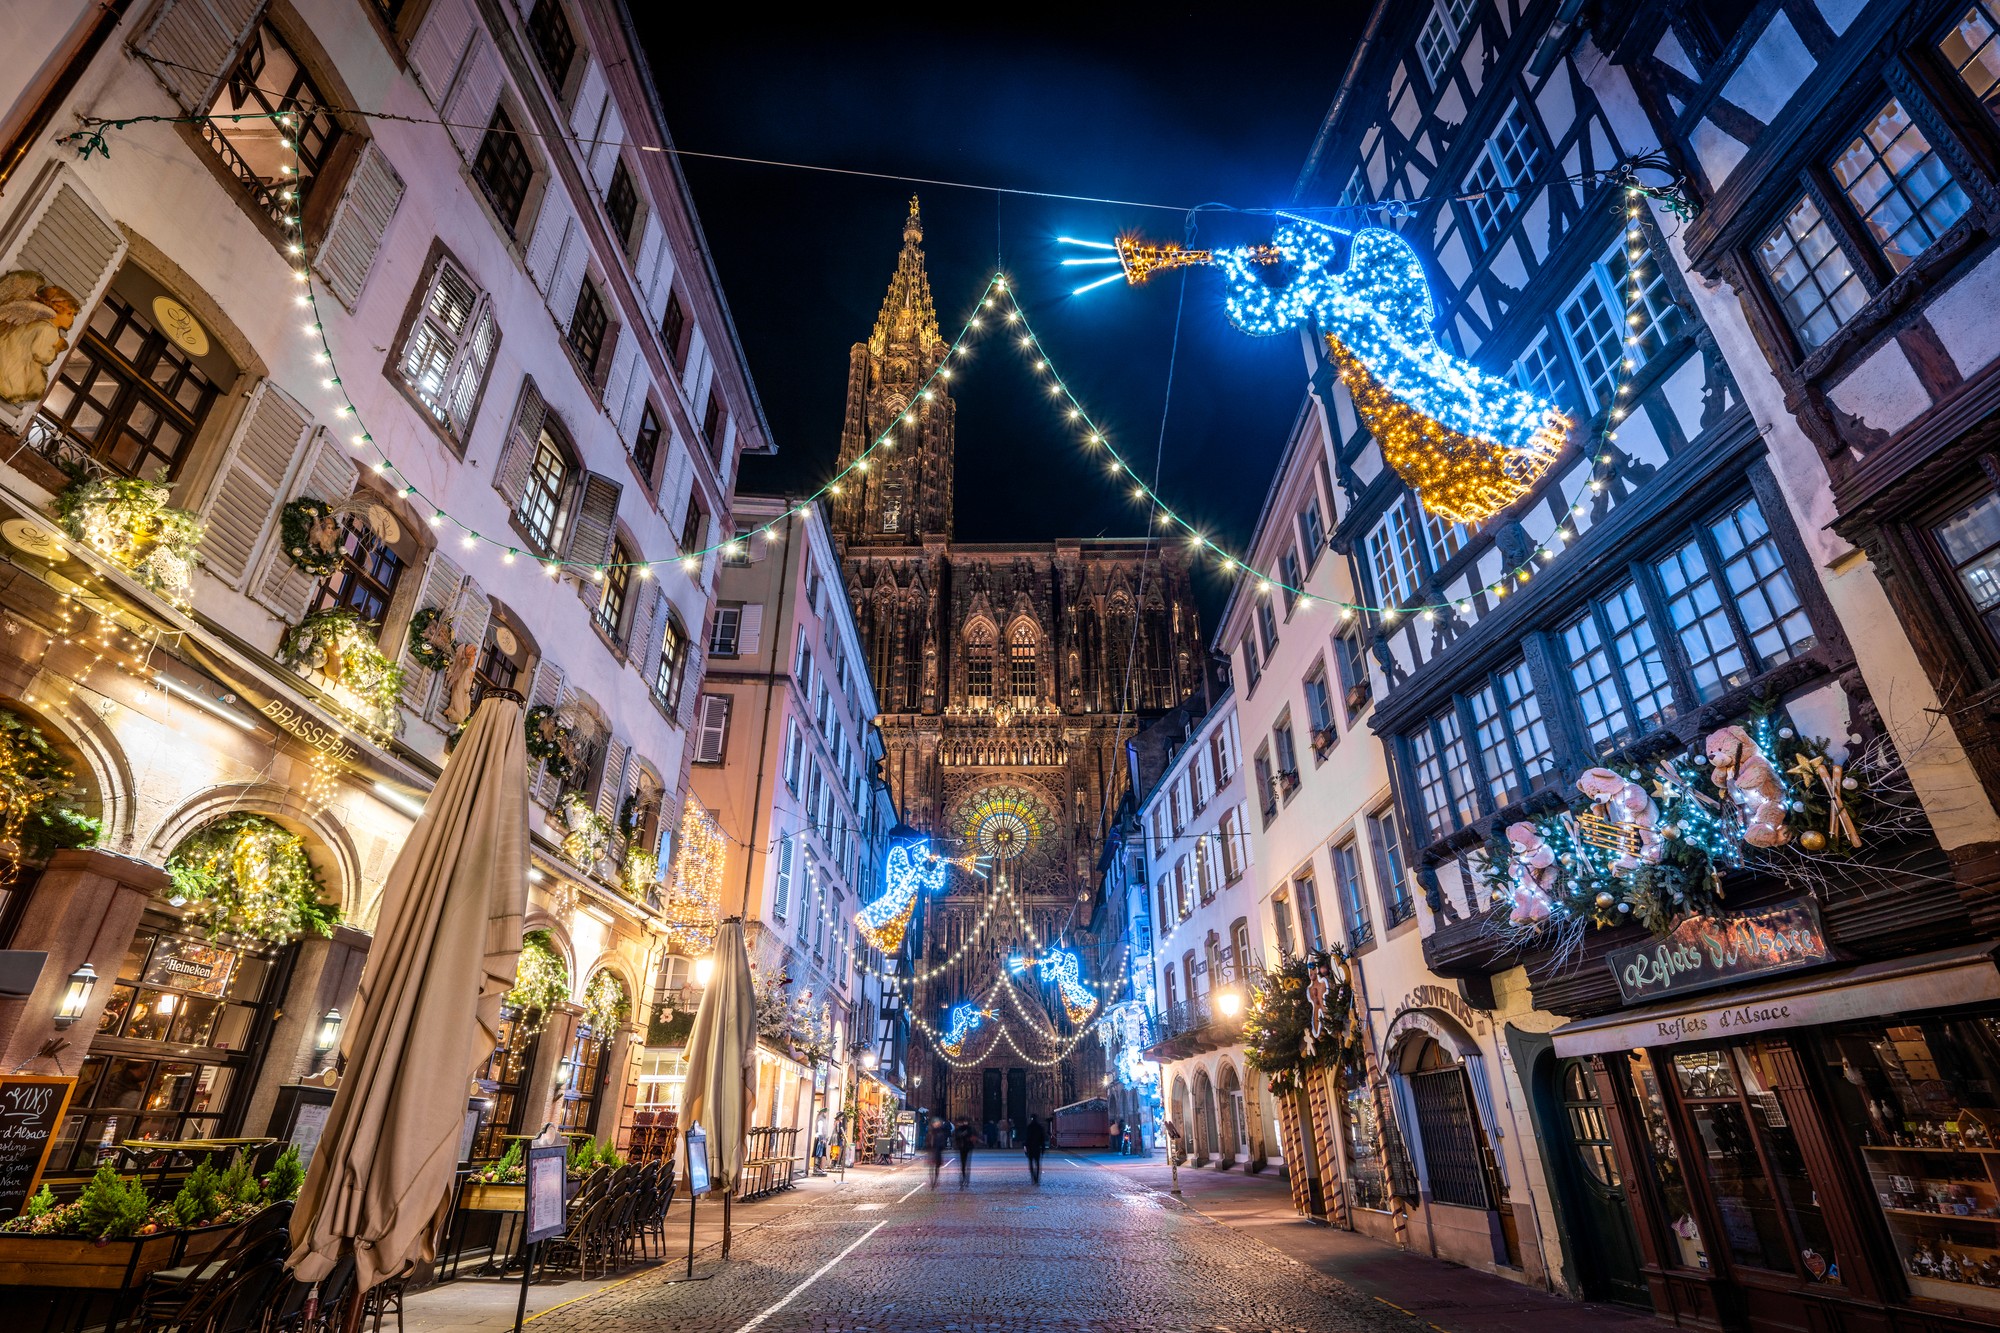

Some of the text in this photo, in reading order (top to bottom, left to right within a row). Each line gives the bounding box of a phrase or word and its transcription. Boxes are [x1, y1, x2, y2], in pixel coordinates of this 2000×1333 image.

[260, 700, 358, 764] BRASSERIE
[168, 959, 211, 977] Heineken
[1624, 943, 1702, 988] Reflets
[1657, 1005, 1791, 1040] Reflets d'Alsace
[6, 1087, 53, 1115] VINS
[3, 1125, 50, 1140] d'Alsace
